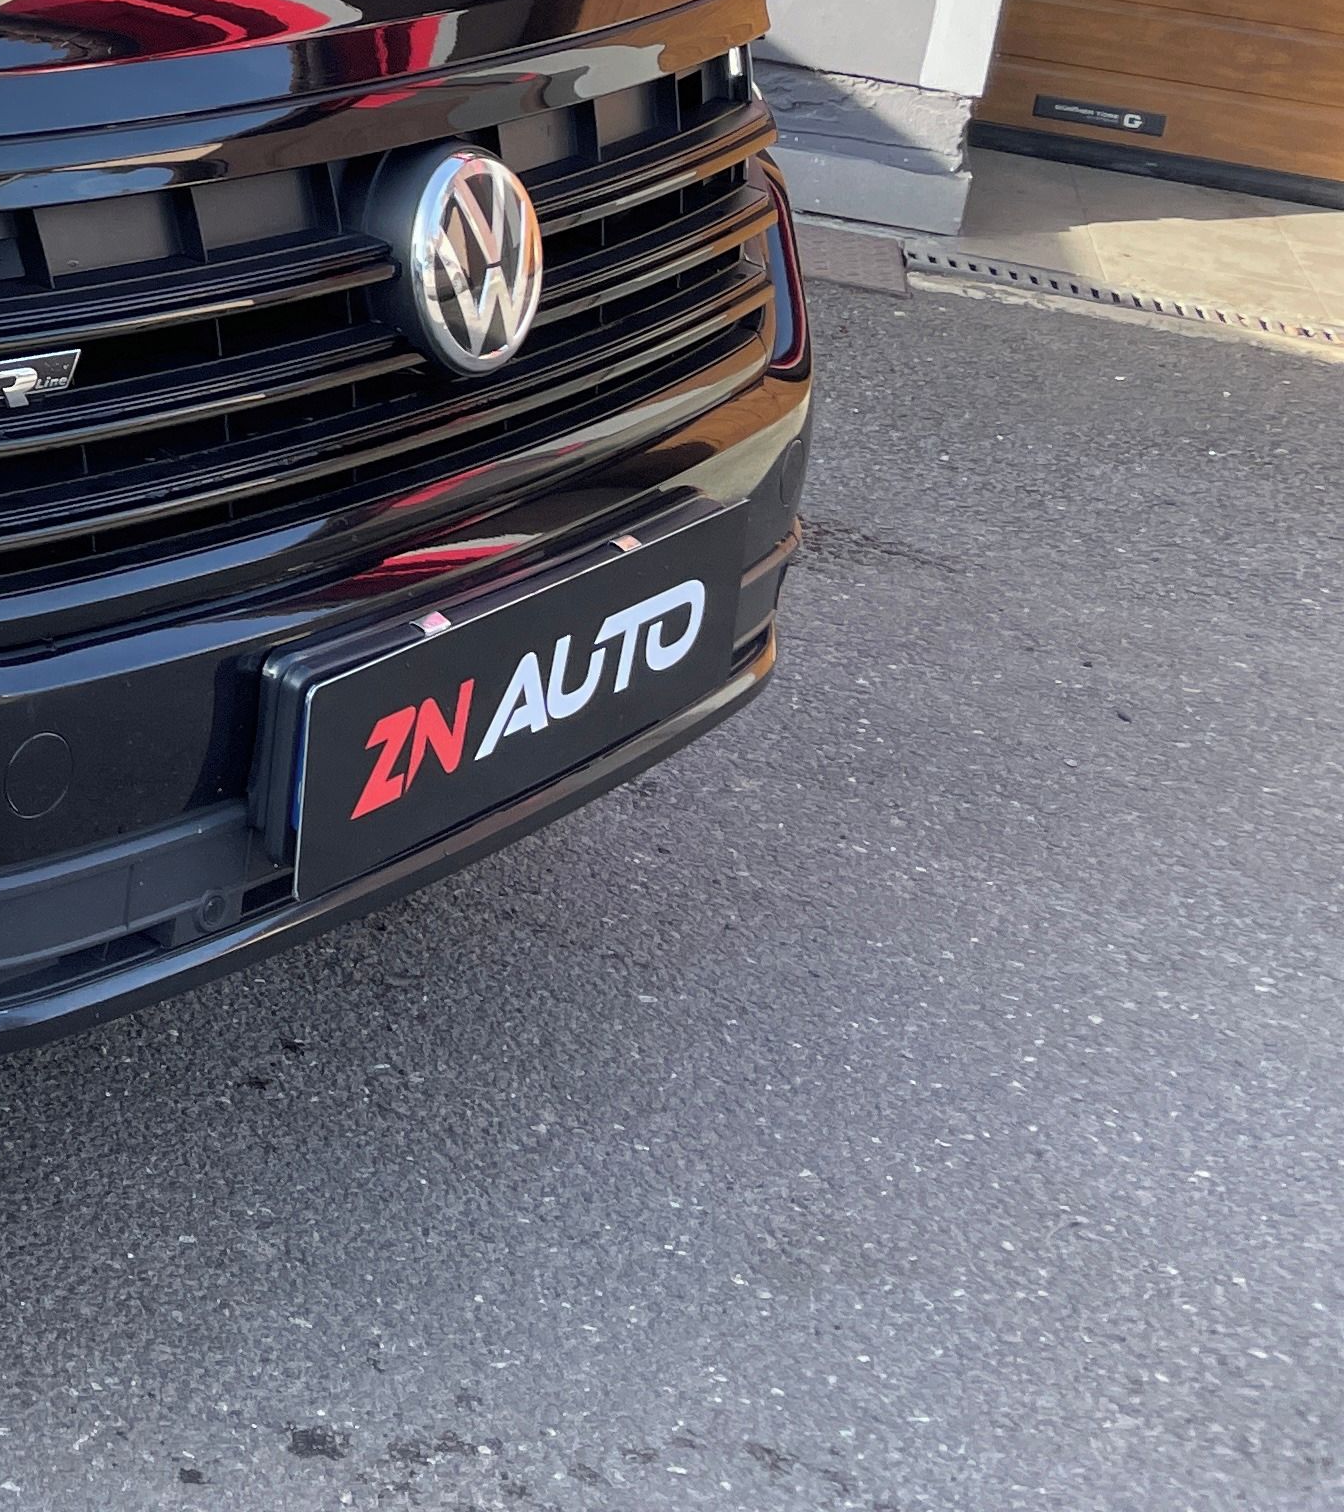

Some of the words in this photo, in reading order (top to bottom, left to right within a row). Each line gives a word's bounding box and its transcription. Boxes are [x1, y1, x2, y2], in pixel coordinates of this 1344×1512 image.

[414, 158, 541, 368] VW
[350, 678, 475, 821] ZN
[474, 578, 707, 762] AUTO
